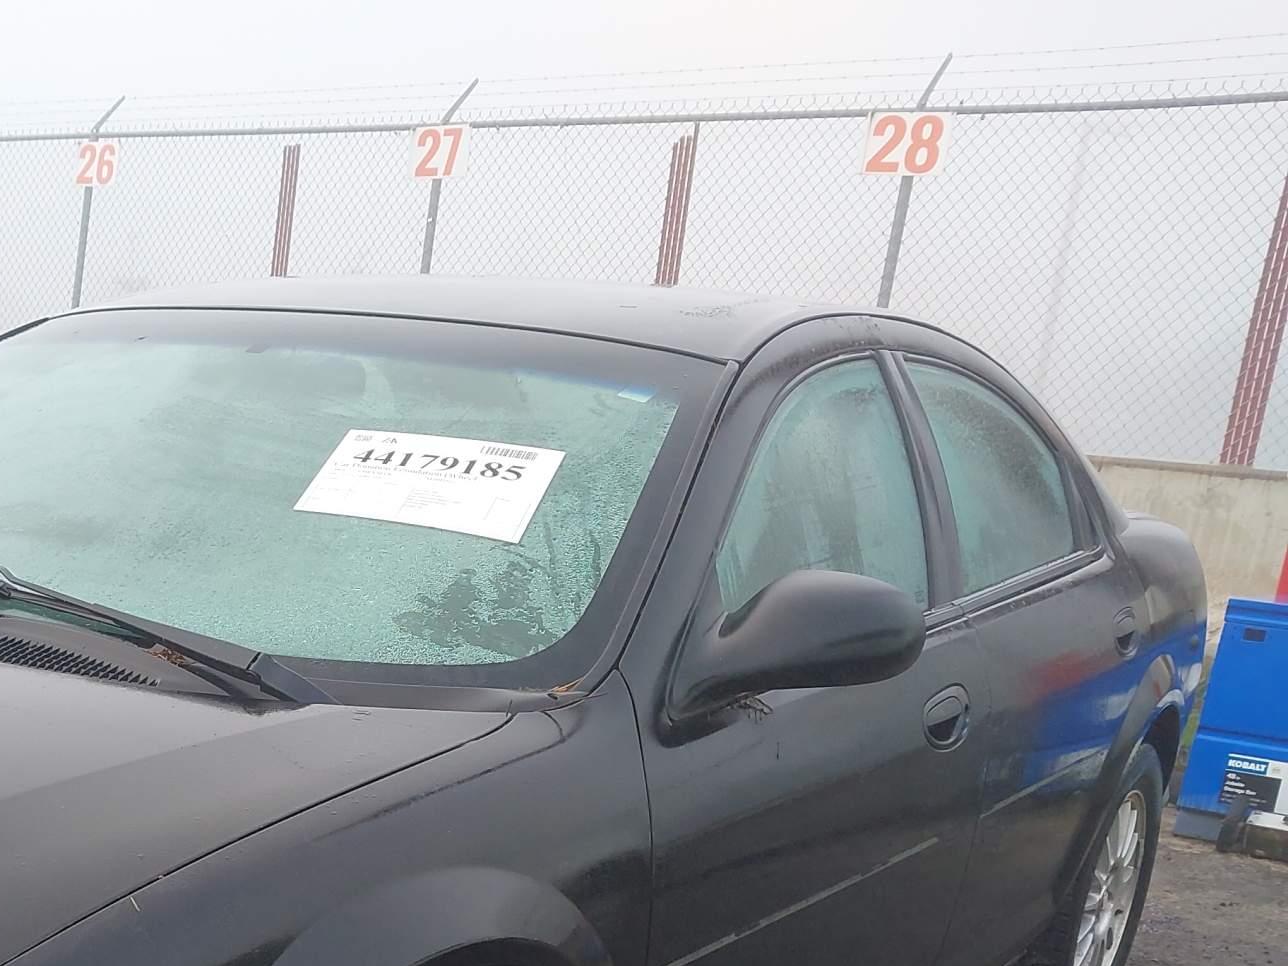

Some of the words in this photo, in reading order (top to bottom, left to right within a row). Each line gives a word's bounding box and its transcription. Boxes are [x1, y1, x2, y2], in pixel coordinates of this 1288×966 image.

[76, 144, 116, 185] 26
[414, 127, 463, 177] 27
[864, 114, 944, 174] 28
[353, 448, 527, 481] 44179185
[1228, 760, 1267, 771] KOBALT
